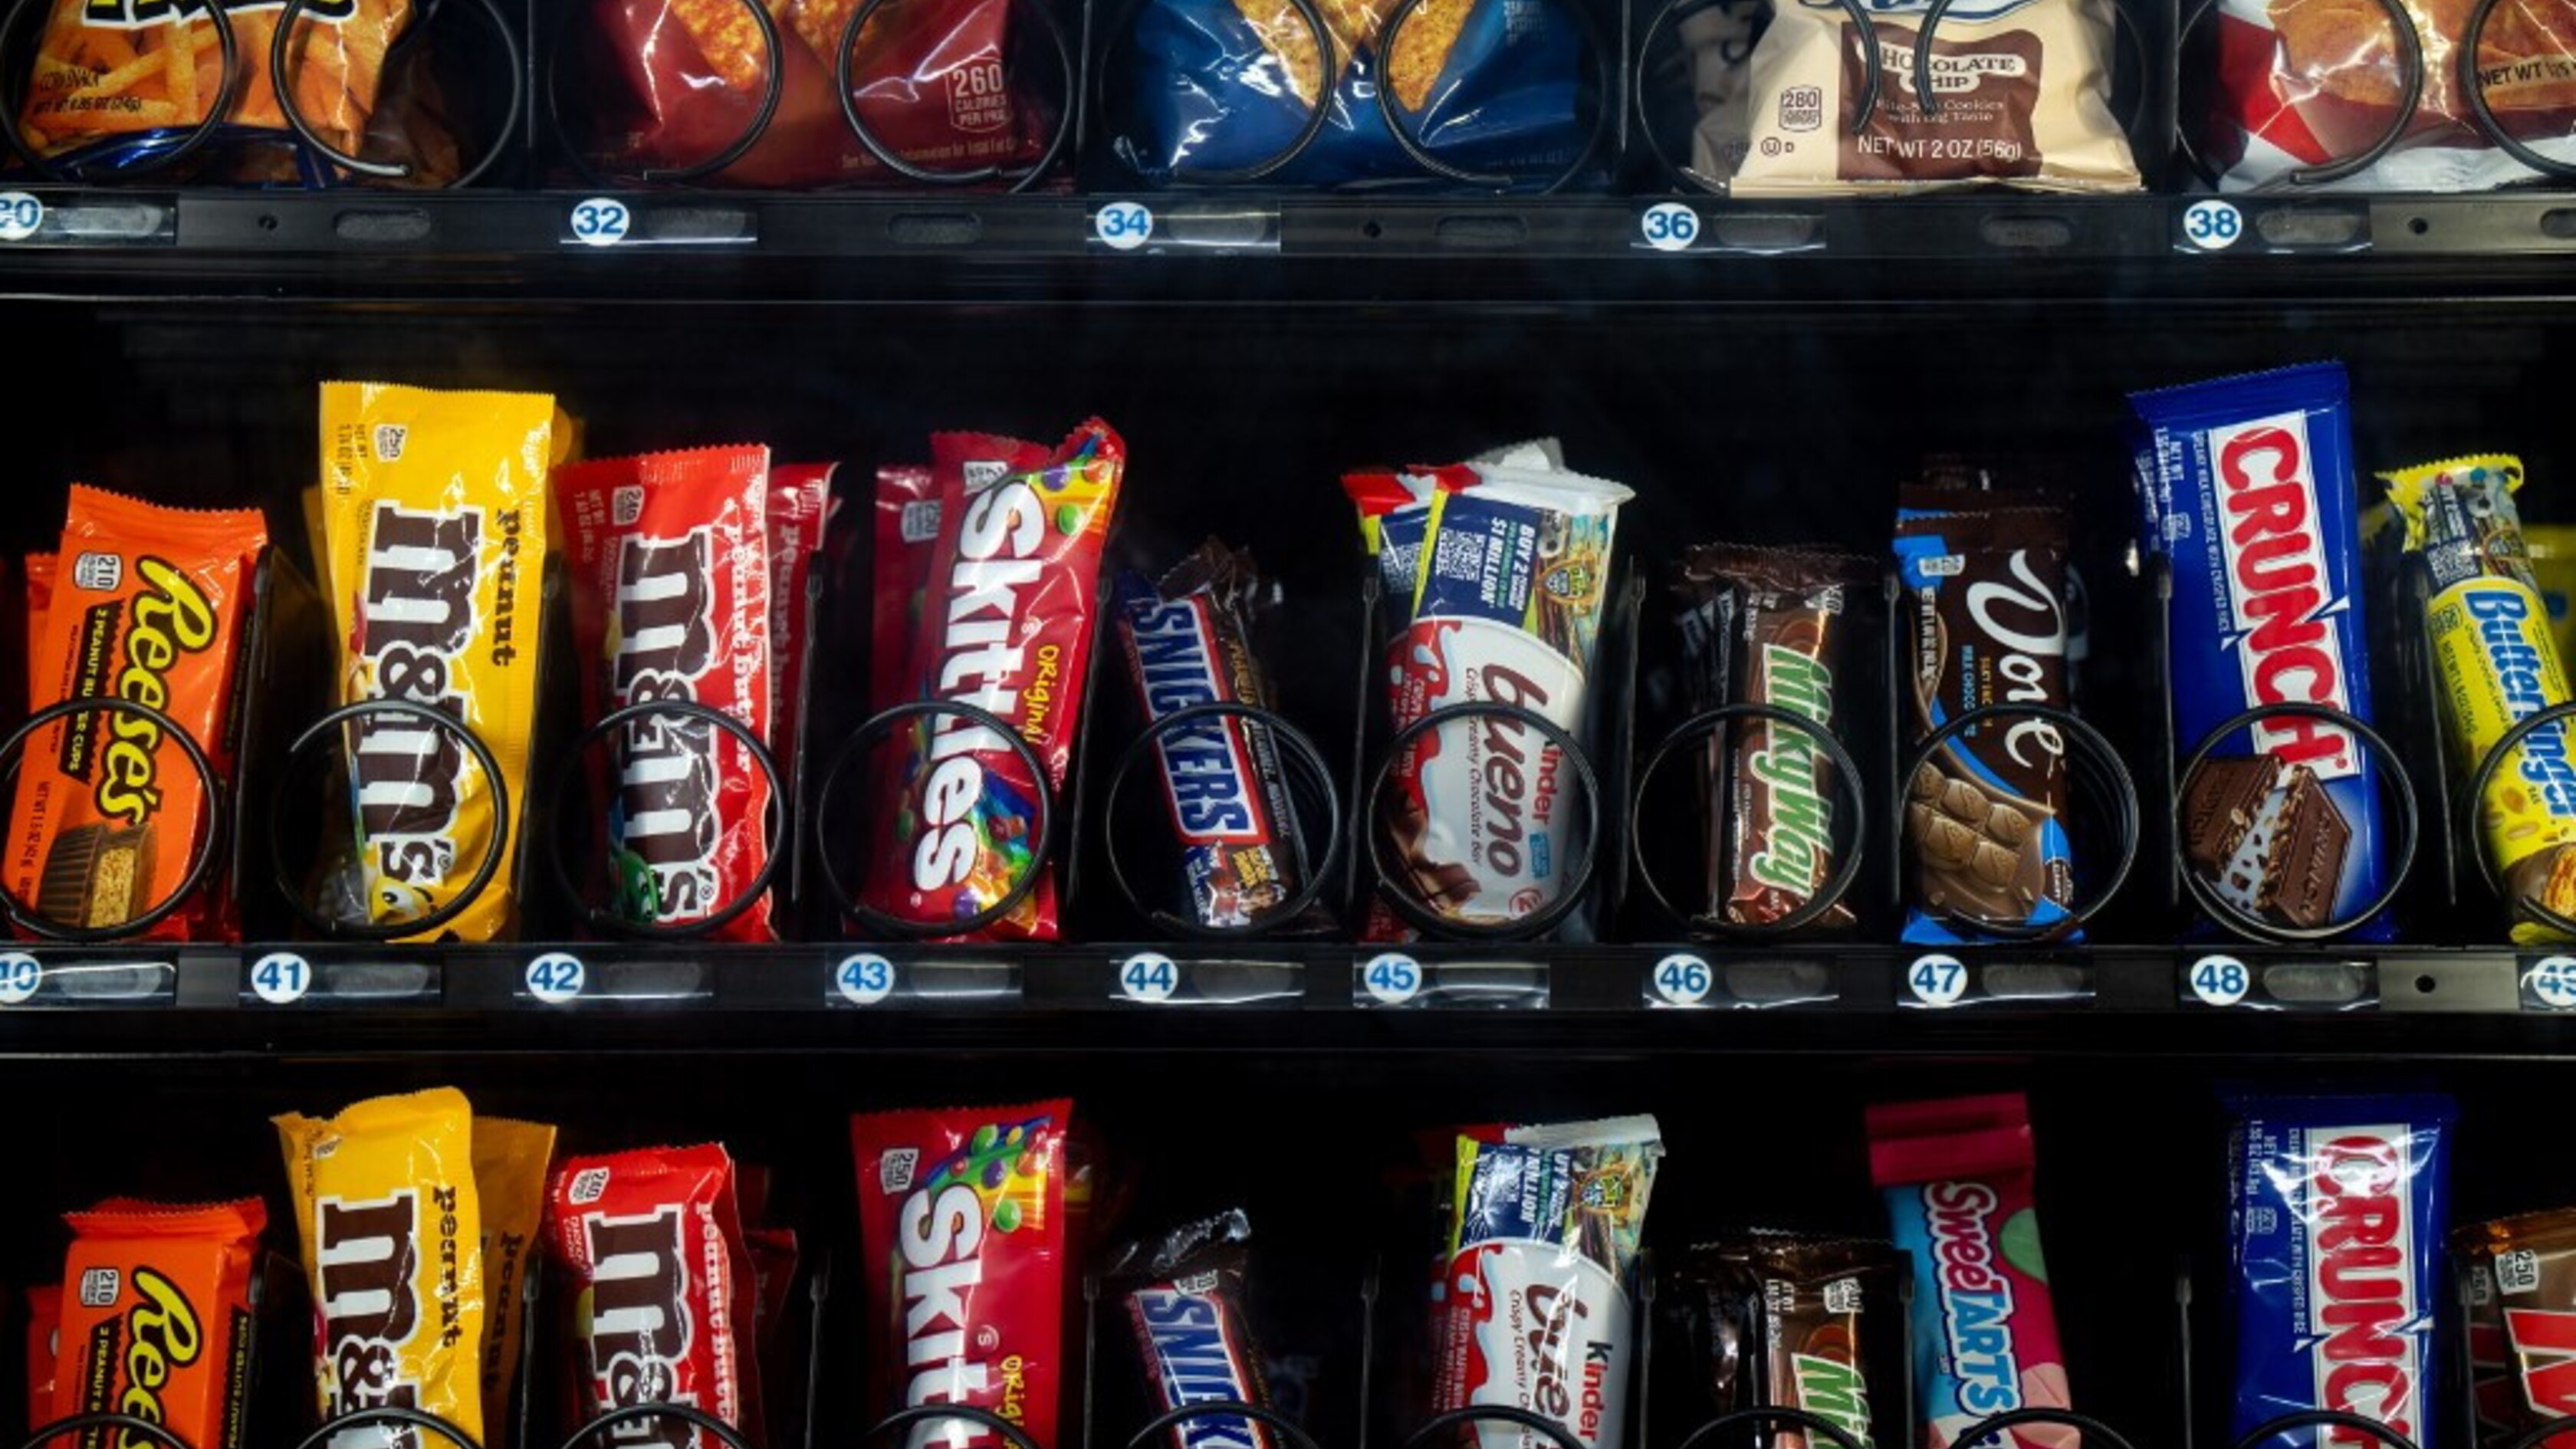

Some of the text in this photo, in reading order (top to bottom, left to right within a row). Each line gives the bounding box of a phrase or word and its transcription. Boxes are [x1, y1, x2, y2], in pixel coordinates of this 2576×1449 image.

[953, 64, 1003, 98] 260
[2514, 64, 2542, 81] WT
[1783, 90, 1818, 110] 280
[1944, 97, 2004, 111] Cookies
[1858, 135, 2022, 163] NET WT 2 OZ (56g)
[576, 206, 624, 235] 32
[1103, 209, 1149, 236] 34
[1647, 211, 1695, 240] 36
[2189, 208, 2238, 238] 38
[389, 427, 406, 459] 250
[625, 490, 642, 519] 240
[1490, 517, 1509, 537] $1
[1516, 523, 1536, 562] BUY
[99, 555, 116, 588] 210
[1513, 562, 1525, 576] 2
[492, 509, 521, 667] peanut
[724, 524, 751, 649] peanut
[2220, 426, 2347, 764] CRUNCH
[87, 619, 105, 677] PEANUT
[1966, 549, 2065, 767] Dove
[100, 559, 213, 824] Reese's
[915, 479, 1046, 892] Skittles
[1466, 667, 1481, 702] Crisp
[1133, 605, 1251, 831] SNICKERS
[67, 734, 84, 771] CUPS
[1481, 663, 1549, 877] bueno
[1533, 731, 1564, 826] inder
[1749, 784, 1834, 901] Way
[256, 961, 301, 991] 41
[530, 961, 580, 991] 42
[841, 961, 887, 991] 43
[1125, 962, 1173, 992] 44
[1368, 961, 1414, 991] 45
[1659, 963, 1707, 993] 46
[1913, 963, 1961, 993] 47
[2195, 964, 2245, 994] 48
[585, 1170, 607, 1199] 240
[895, 1152, 914, 1186] 250
[432, 1187, 463, 1349] peanut
[695, 1201, 725, 1329] peanut
[2515, 1251, 2535, 1286] 250
[97, 1271, 115, 1303] 210
[1509, 1289, 1530, 1389] Crispy Creamy
[92, 1341, 108, 1398] PEANUT
[1579, 1340, 1613, 1441] Kinder
